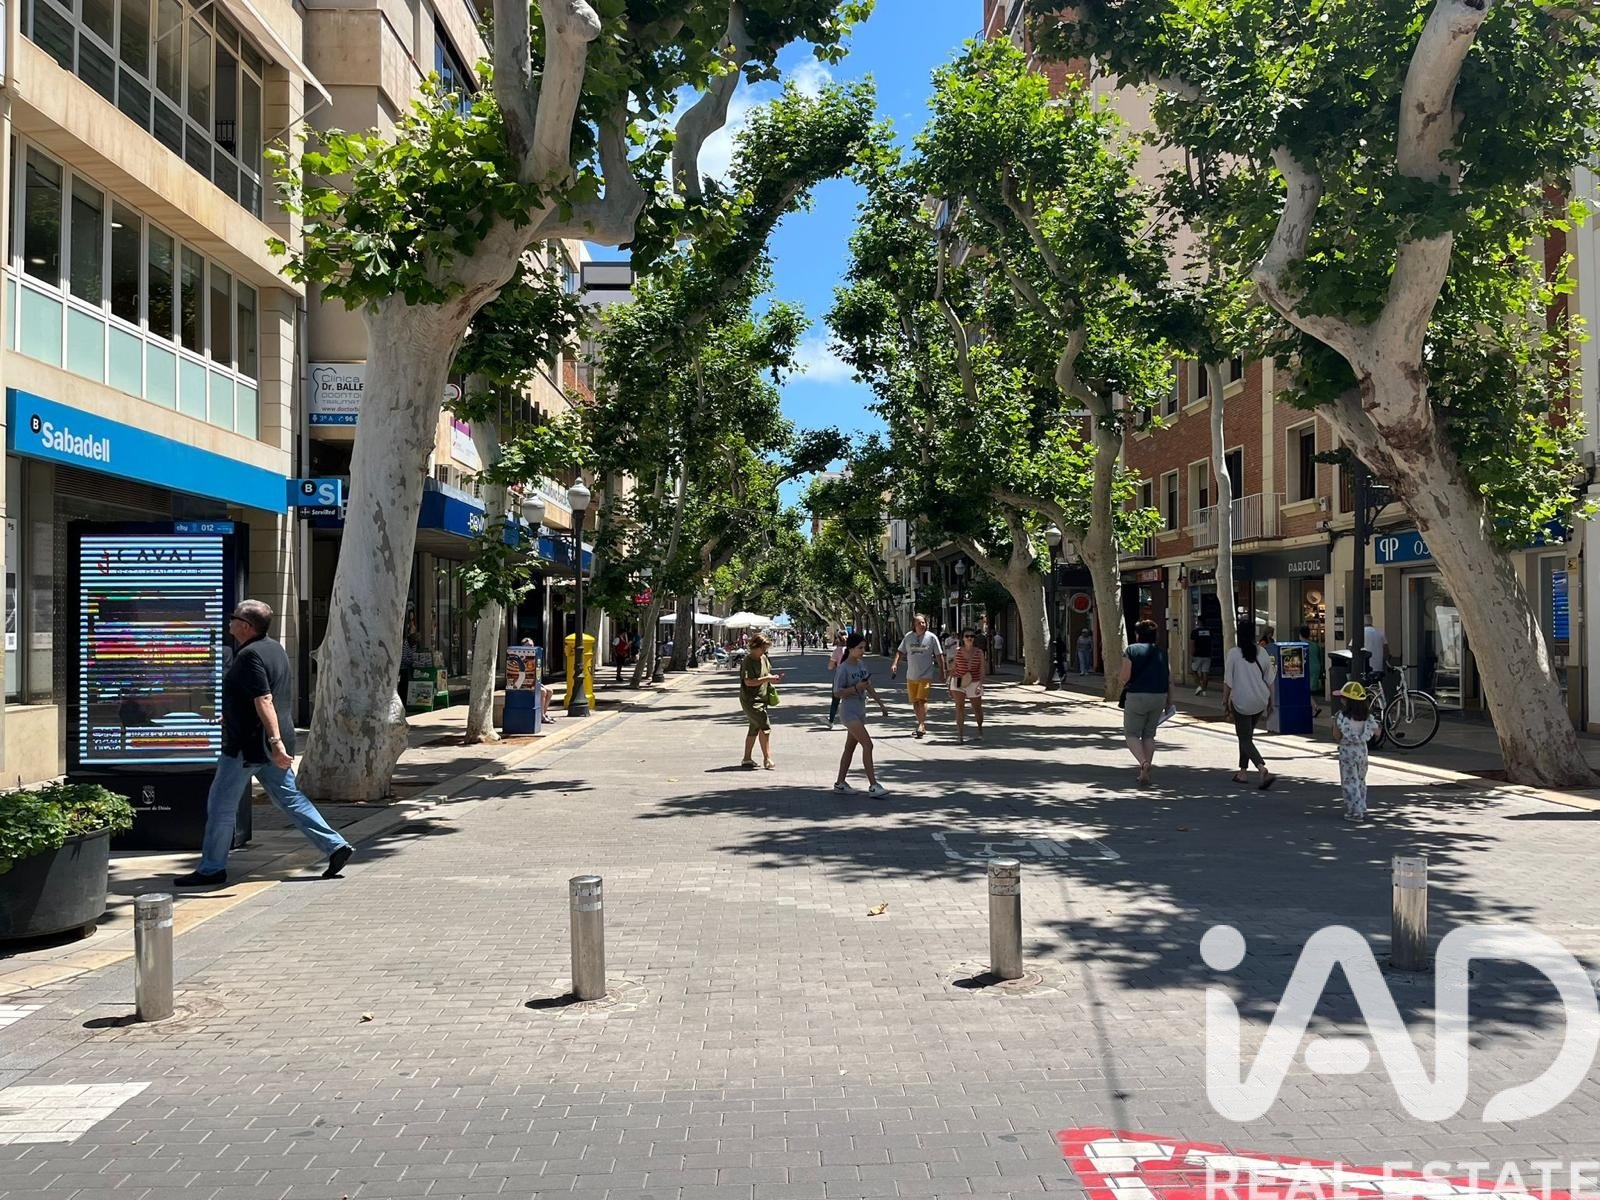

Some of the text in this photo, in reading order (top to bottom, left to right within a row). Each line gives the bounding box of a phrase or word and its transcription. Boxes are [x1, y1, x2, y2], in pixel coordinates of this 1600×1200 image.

[321, 383, 335, 391] Dr.
[33, 418, 39, 430] B
[41, 422, 110, 462] Sabadell
[305, 483, 313, 493] B
[318, 483, 336, 505] S
[201, 524, 214, 532] 012
[1287, 559, 1321, 573] PARFOIS
